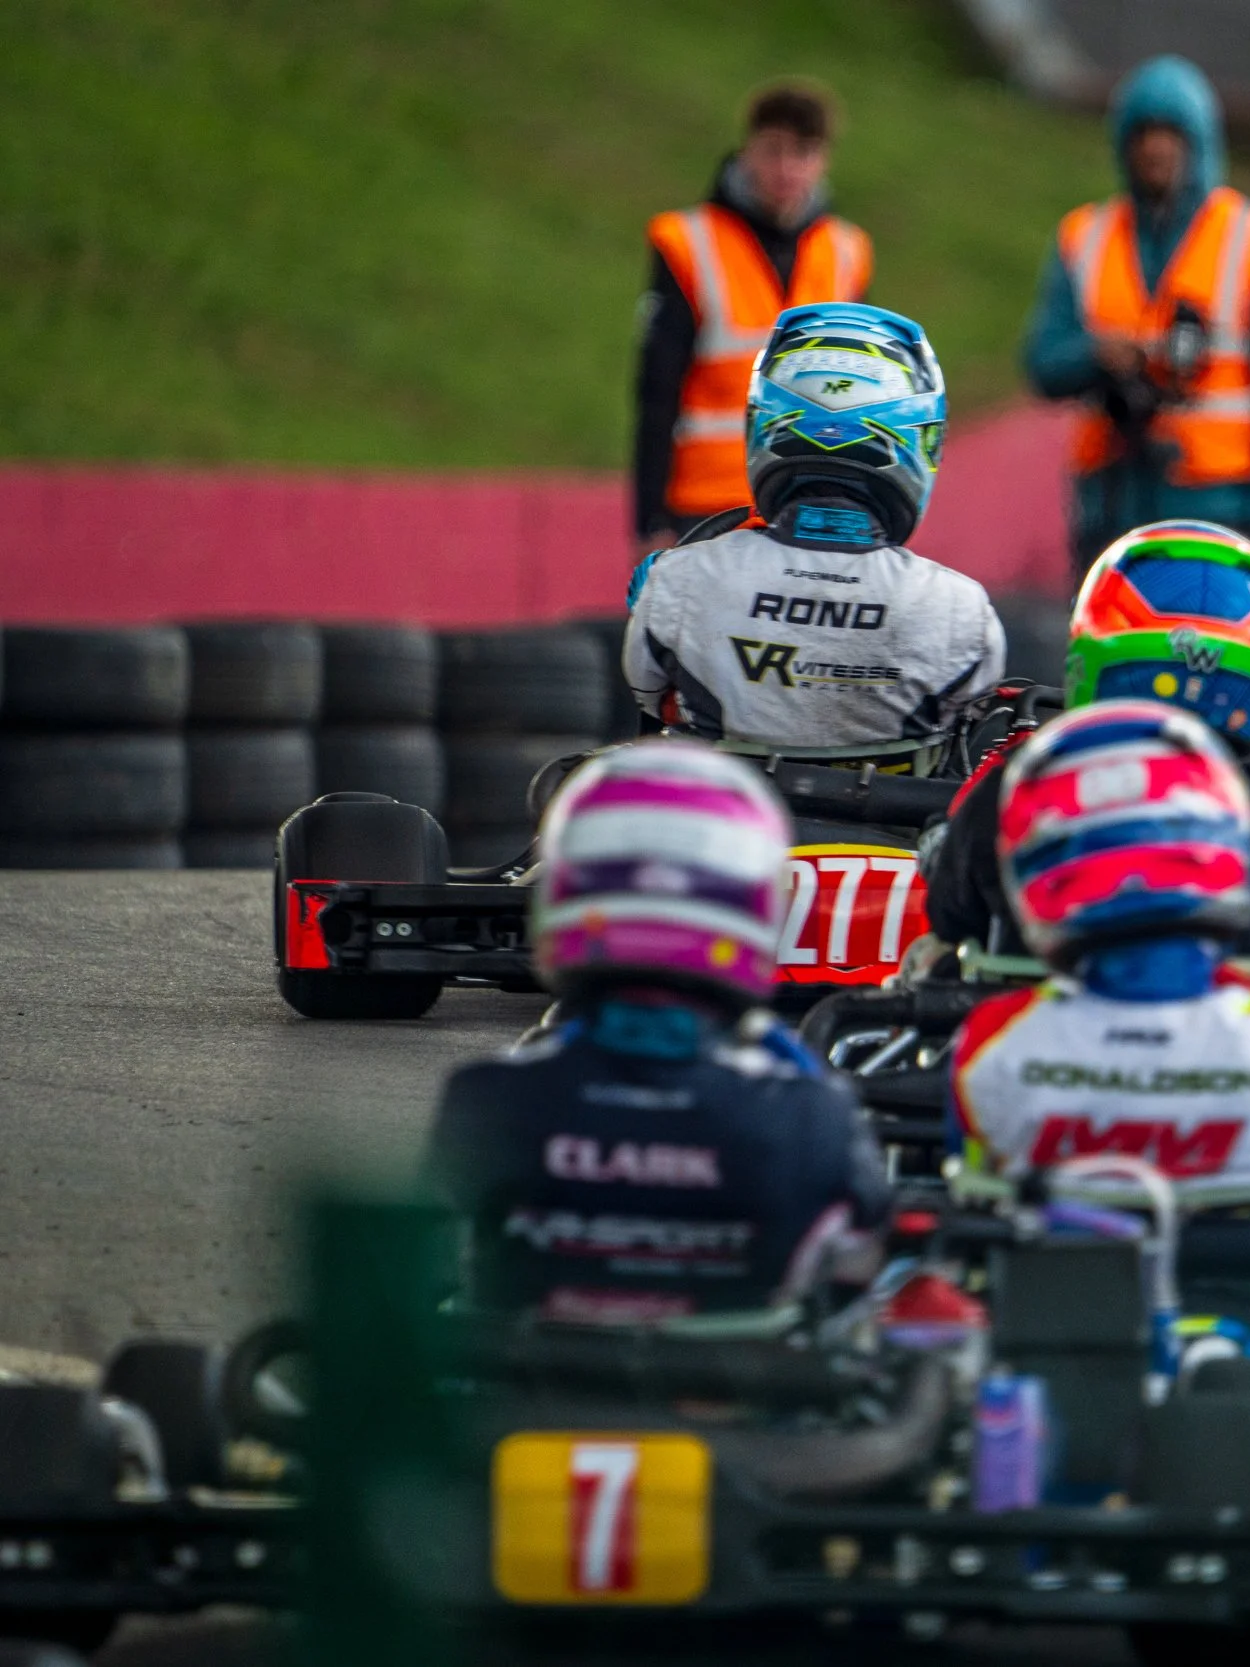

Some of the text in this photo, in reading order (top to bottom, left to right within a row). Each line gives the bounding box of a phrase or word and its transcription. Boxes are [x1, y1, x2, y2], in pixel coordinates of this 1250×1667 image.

[749, 592, 887, 630] ROND
[793, 661, 902, 680] VITESSE
[777, 857, 918, 965] 277
[544, 1133, 722, 1187] CLARK
[570, 1441, 640, 1590] 7
